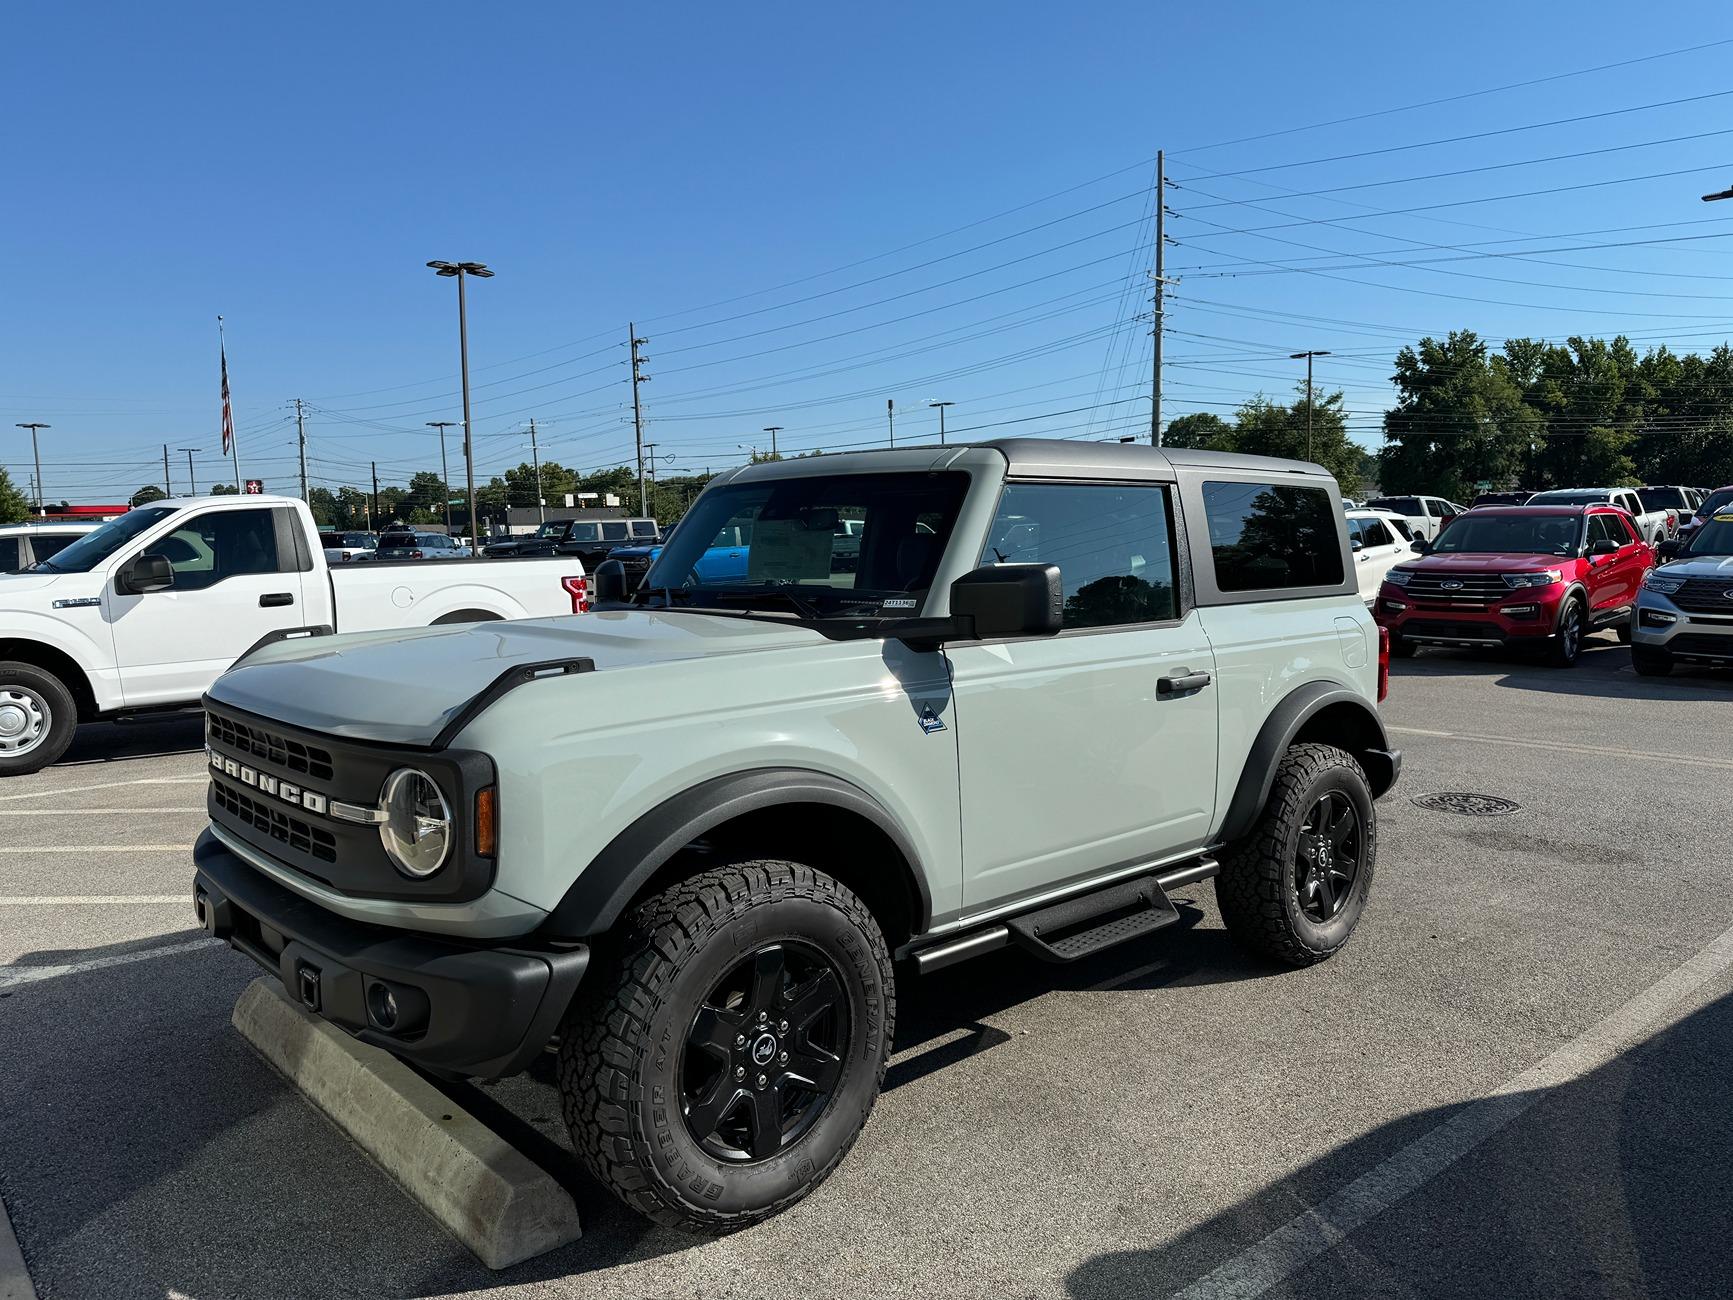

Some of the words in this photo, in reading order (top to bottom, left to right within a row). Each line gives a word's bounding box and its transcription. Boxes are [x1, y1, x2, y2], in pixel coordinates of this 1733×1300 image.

[211, 750, 326, 814] BRONCO
[836, 931, 880, 1062] GENERAL
[652, 1085, 726, 1201] GRABBER
